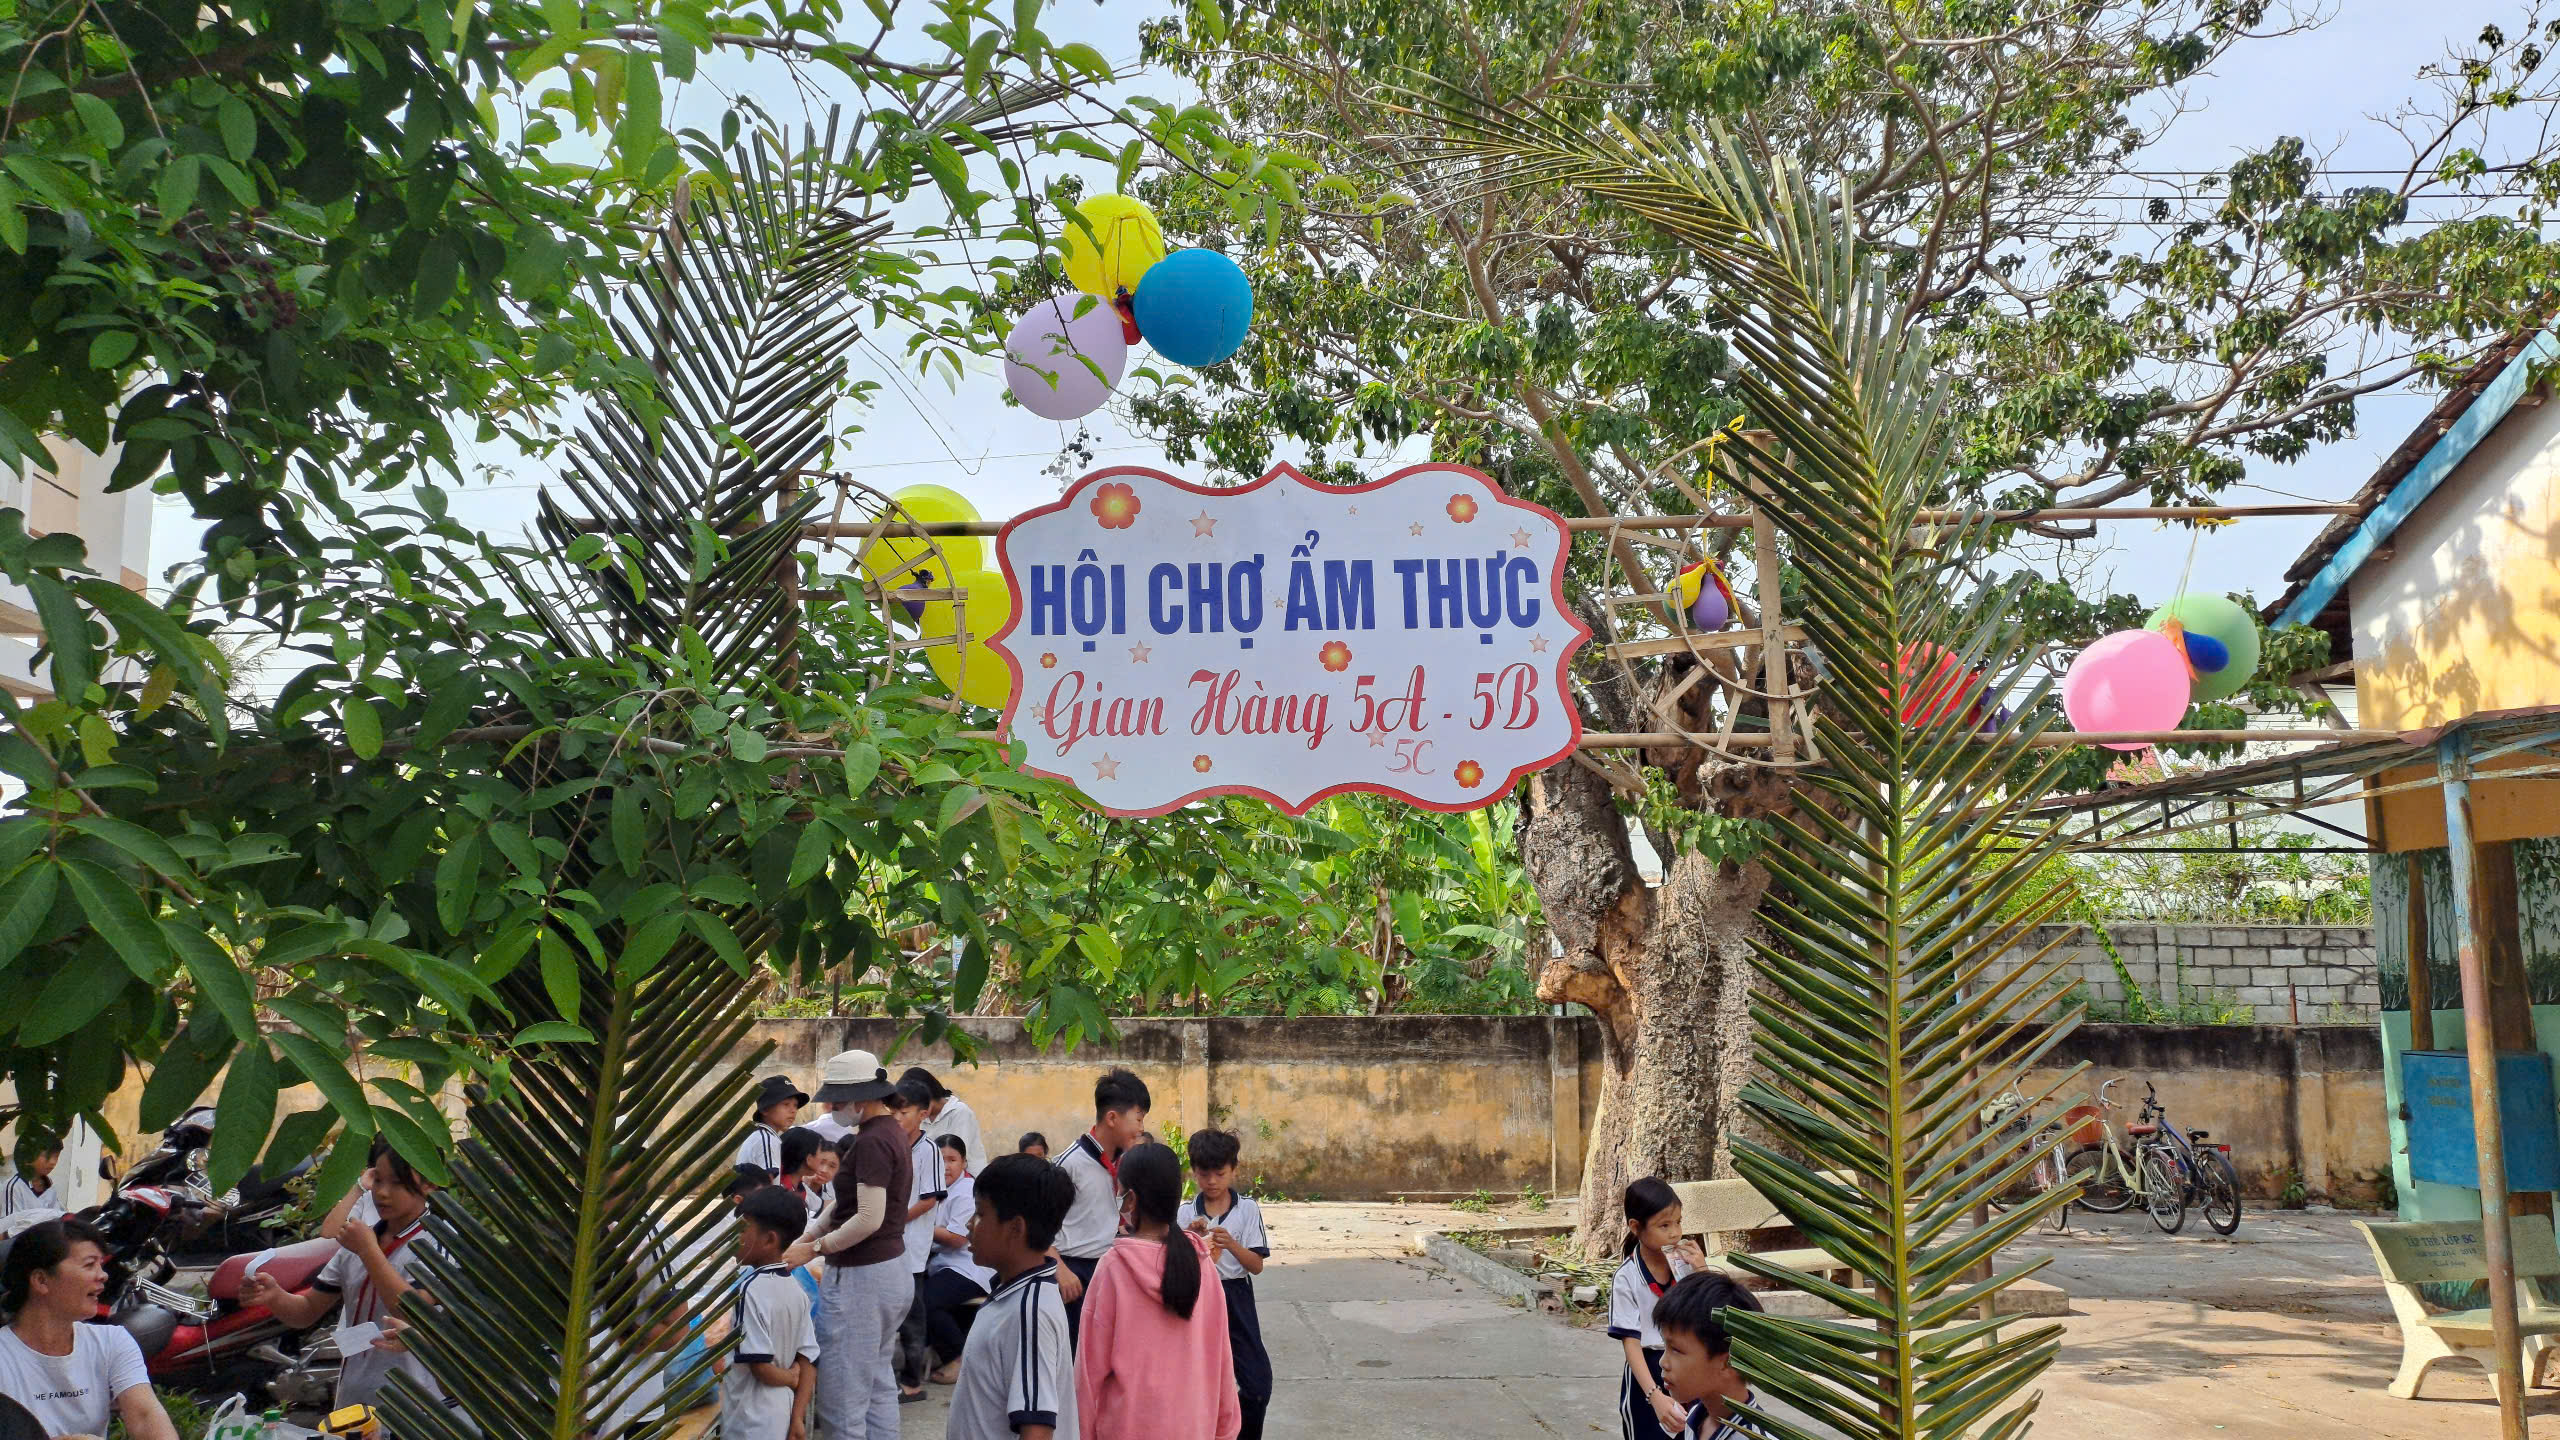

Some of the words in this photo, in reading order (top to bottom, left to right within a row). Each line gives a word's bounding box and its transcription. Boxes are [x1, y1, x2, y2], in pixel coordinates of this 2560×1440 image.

[1030, 548, 1126, 652] HỘI
[1148, 553, 1265, 650] CHỢ
[1283, 529, 1376, 632] ẨM
[1393, 550, 1540, 645] THỰC
[1038, 670, 1169, 757] Gian
[1187, 669, 1334, 750] Hàng
[1349, 664, 1428, 732] 5A
[1469, 662, 1540, 730] 5B
[1385, 738, 1436, 775] 5C
